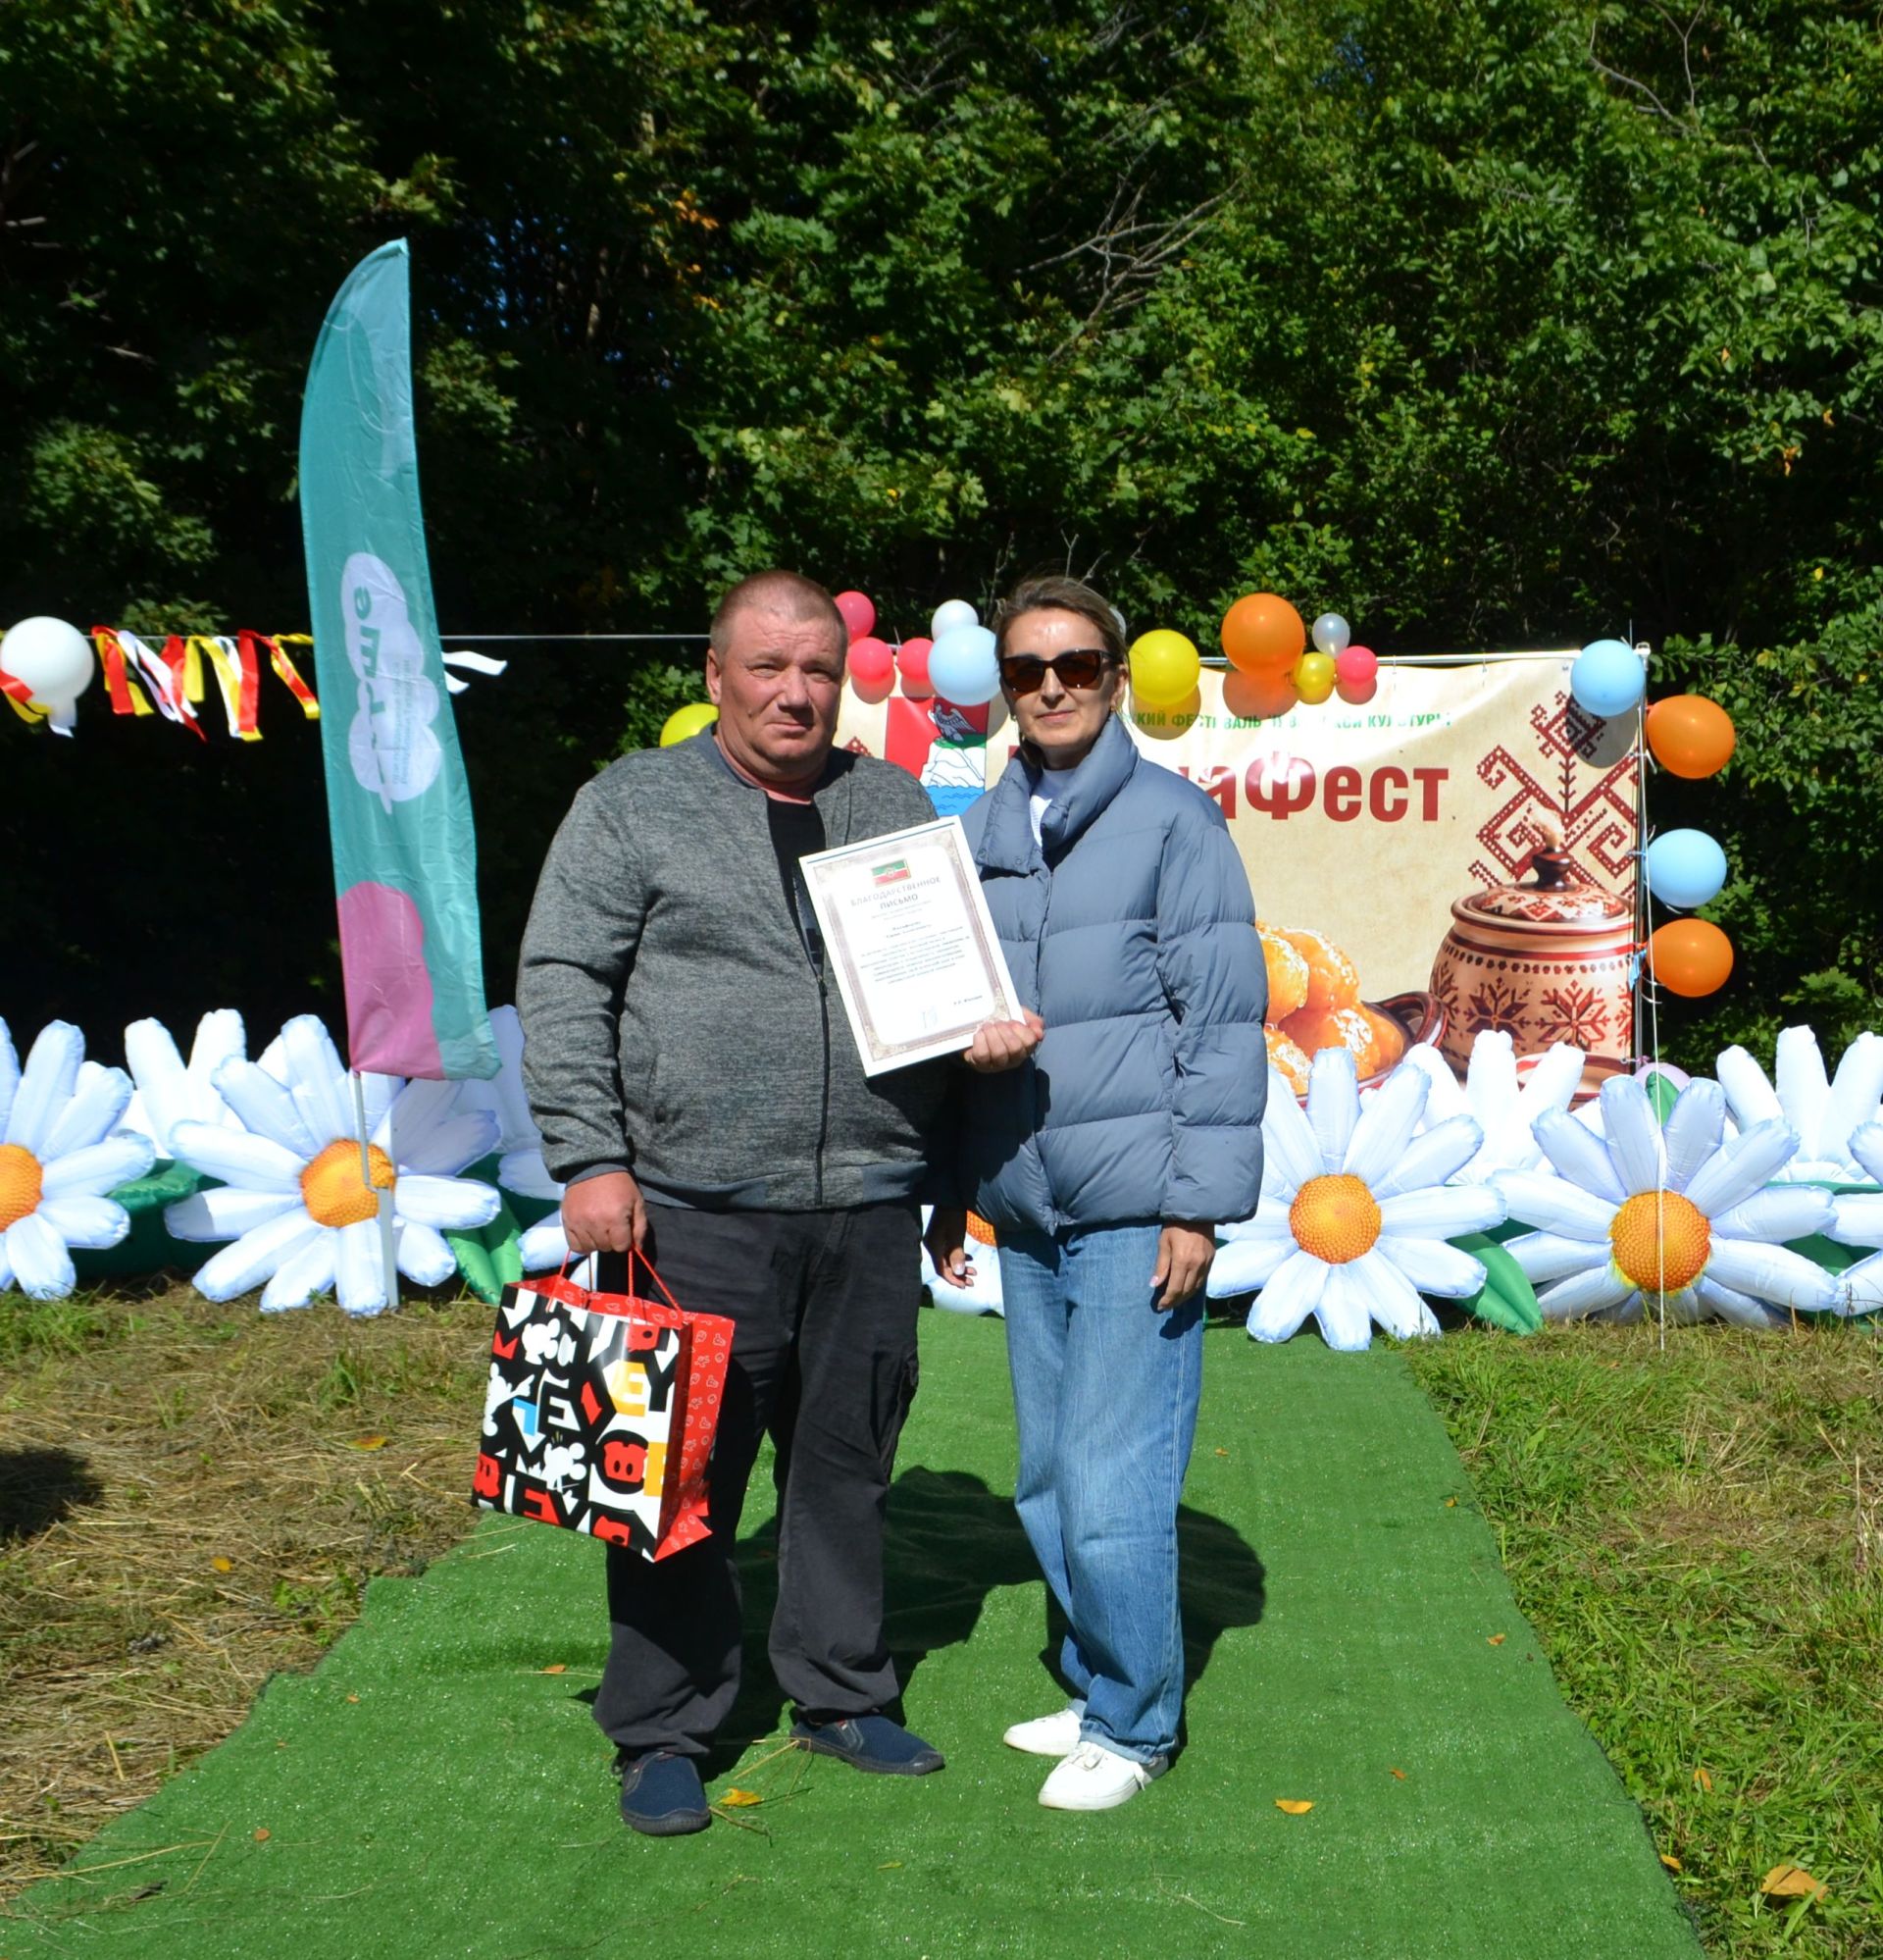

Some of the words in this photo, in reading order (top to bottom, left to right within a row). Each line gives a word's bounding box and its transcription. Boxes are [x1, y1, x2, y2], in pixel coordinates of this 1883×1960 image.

[1136, 709, 1167, 727] КИЙ
[1178, 749, 1450, 823] аФест
[850, 876, 942, 907] БЛАГОДАРСТВЕННОЕ
[880, 893, 919, 910] ПИСЬМО
